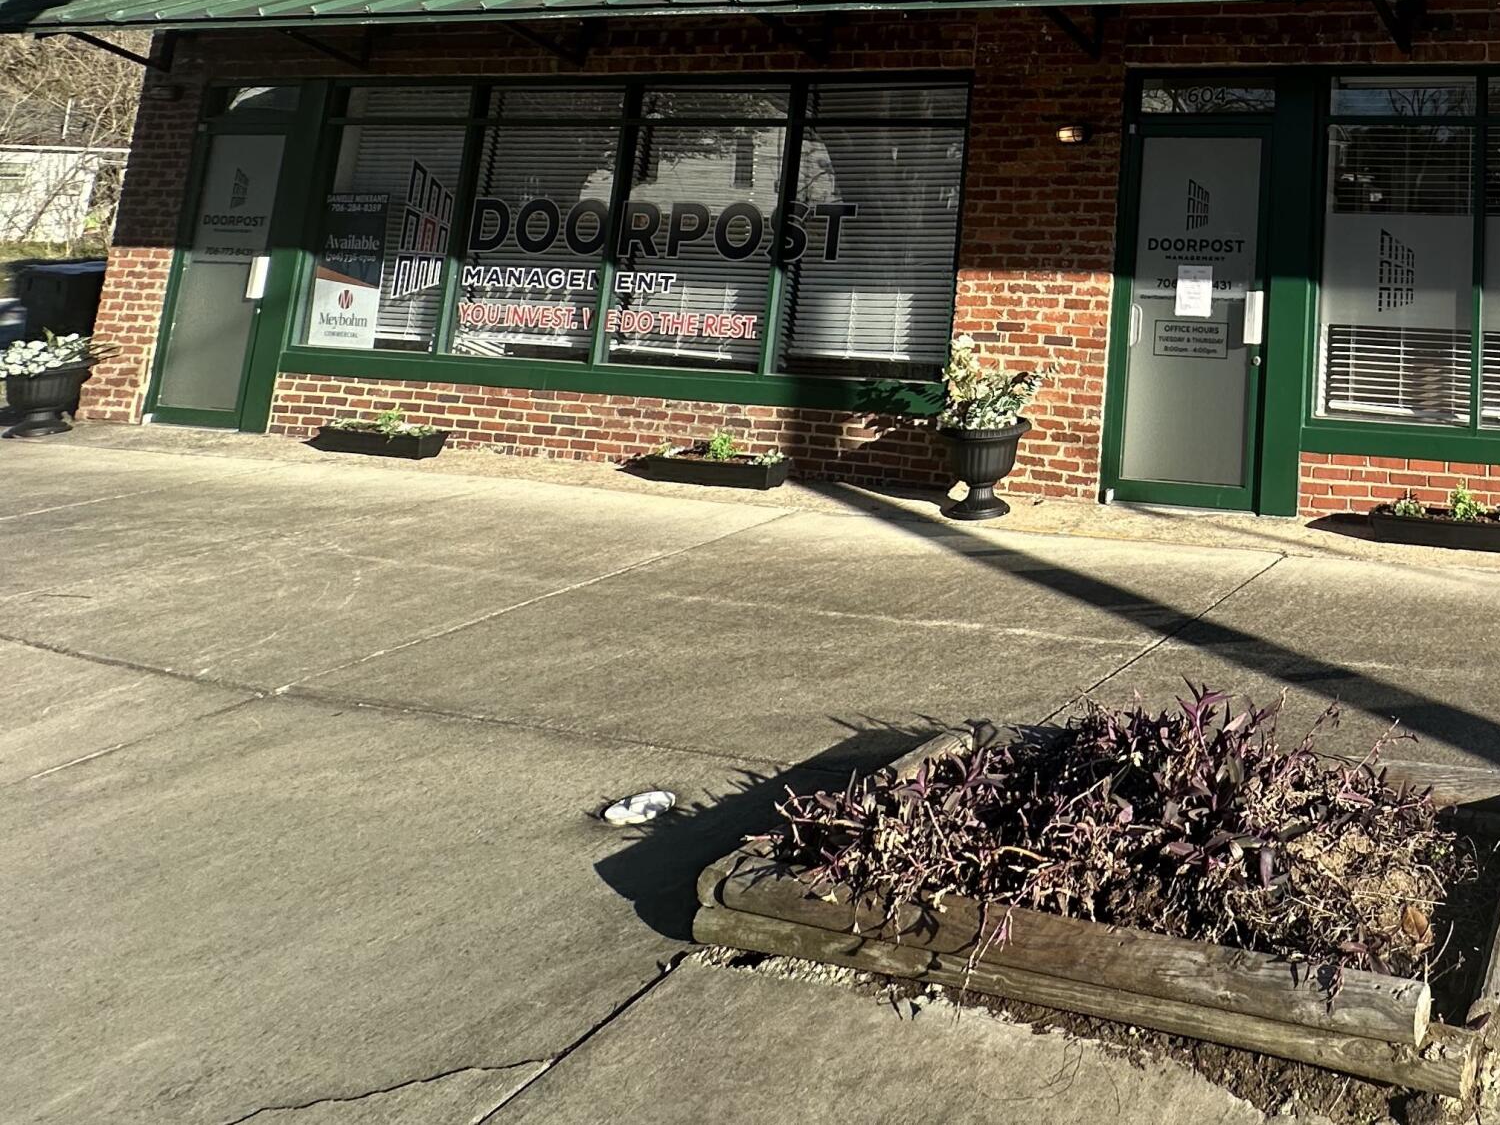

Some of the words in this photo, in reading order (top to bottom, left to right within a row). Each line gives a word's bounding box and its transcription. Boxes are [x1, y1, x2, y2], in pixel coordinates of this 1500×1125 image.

[1187, 86, 1227, 104] 604
[203, 215, 265, 227] DOORPOST
[468, 197, 858, 263] DOORPOST
[325, 235, 379, 251] Available
[1147, 238, 1245, 253] DOORPOST
[319, 312, 367, 329] Meybohm
[458, 302, 501, 325] YOU
[505, 304, 578, 330] INVEST.
[620, 309, 654, 334] DO
[658, 311, 699, 337] THE
[702, 314, 757, 339] REST.
[1164, 324, 1190, 333] OFFICE
[1191, 325, 1220, 334] HOURS
[1158, 335, 1185, 343] TUESDAY
[1192, 336, 1224, 345] THURSDAY
